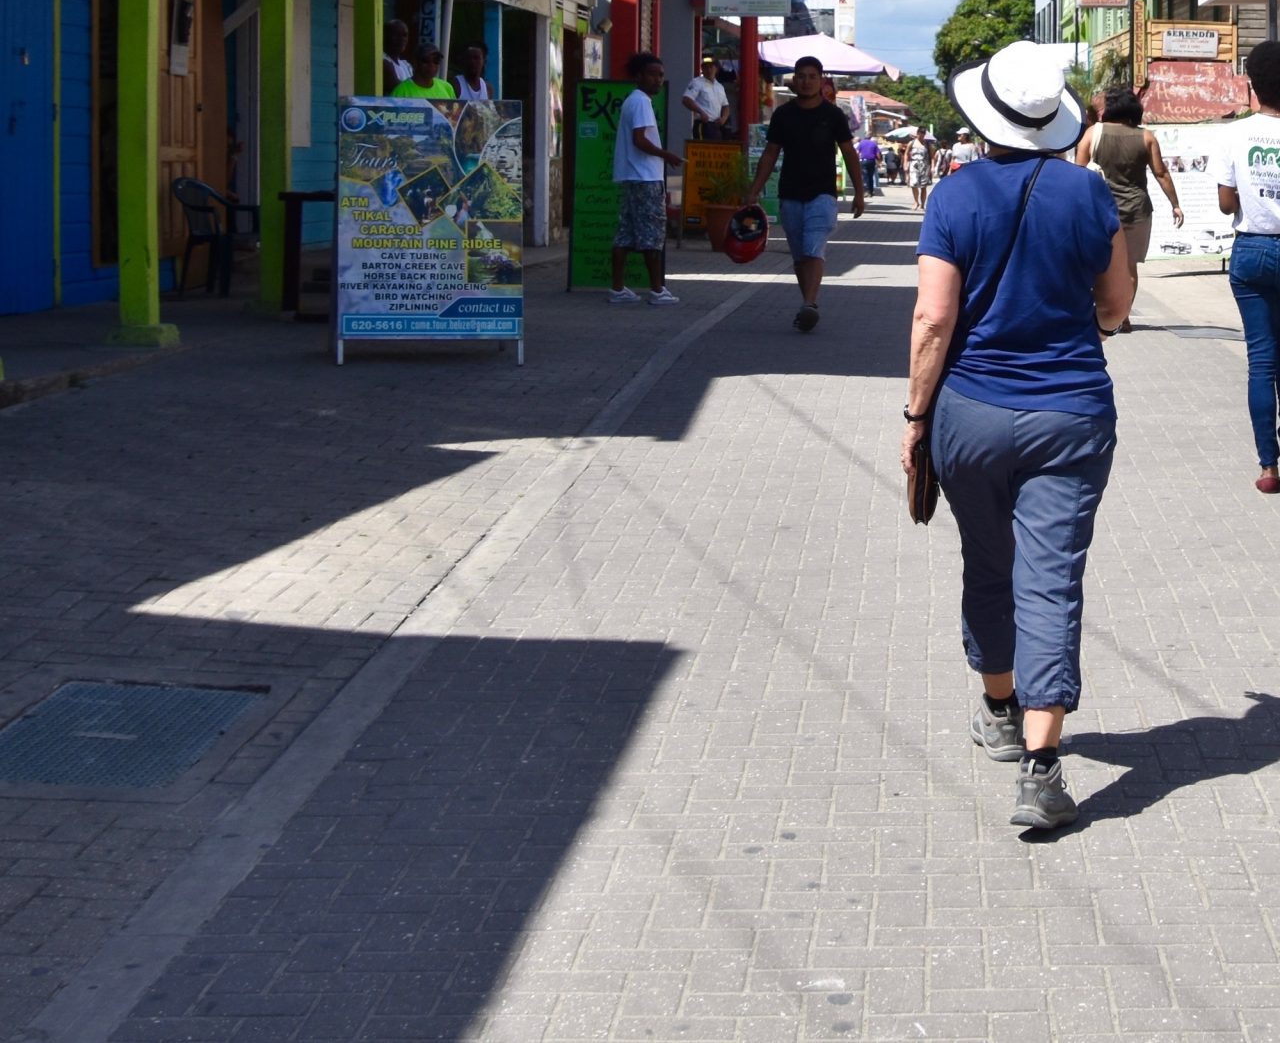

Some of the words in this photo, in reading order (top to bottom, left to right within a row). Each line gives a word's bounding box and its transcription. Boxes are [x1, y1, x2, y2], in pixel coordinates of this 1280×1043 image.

[1134, 0, 1144, 84] SERENDIB
[367, 110, 425, 126] XPLORE
[349, 142, 400, 170] Tours
[341, 196, 369, 208] ATM
[352, 211, 392, 222] TIKAL
[360, 224, 423, 236] CARACOL
[352, 238, 424, 250] MOUNTAIN
[426, 238, 457, 250] PINE
[461, 238, 503, 250] RIDGE
[380, 252, 408, 260] CAVE
[409, 252, 448, 260] TUBING
[361, 262, 402, 270] BARTON
[403, 262, 438, 270] CREEK
[440, 262, 466, 270] CAVE
[363, 272, 398, 281] HORSE
[400, 272, 426, 281] BACK
[429, 272, 464, 281] RIDING
[340, 282, 370, 291] RIVER
[372, 282, 424, 291] KAYAKING
[426, 282, 434, 291] &
[436, 282, 488, 291] CANOEING
[374, 292, 399, 302] BIRD
[400, 292, 453, 302] WATCHING
[388, 302, 439, 312] ZIPLINING
[457, 302, 500, 314] contact
[502, 304, 516, 314] us
[351, 320, 403, 331] 620-5616
